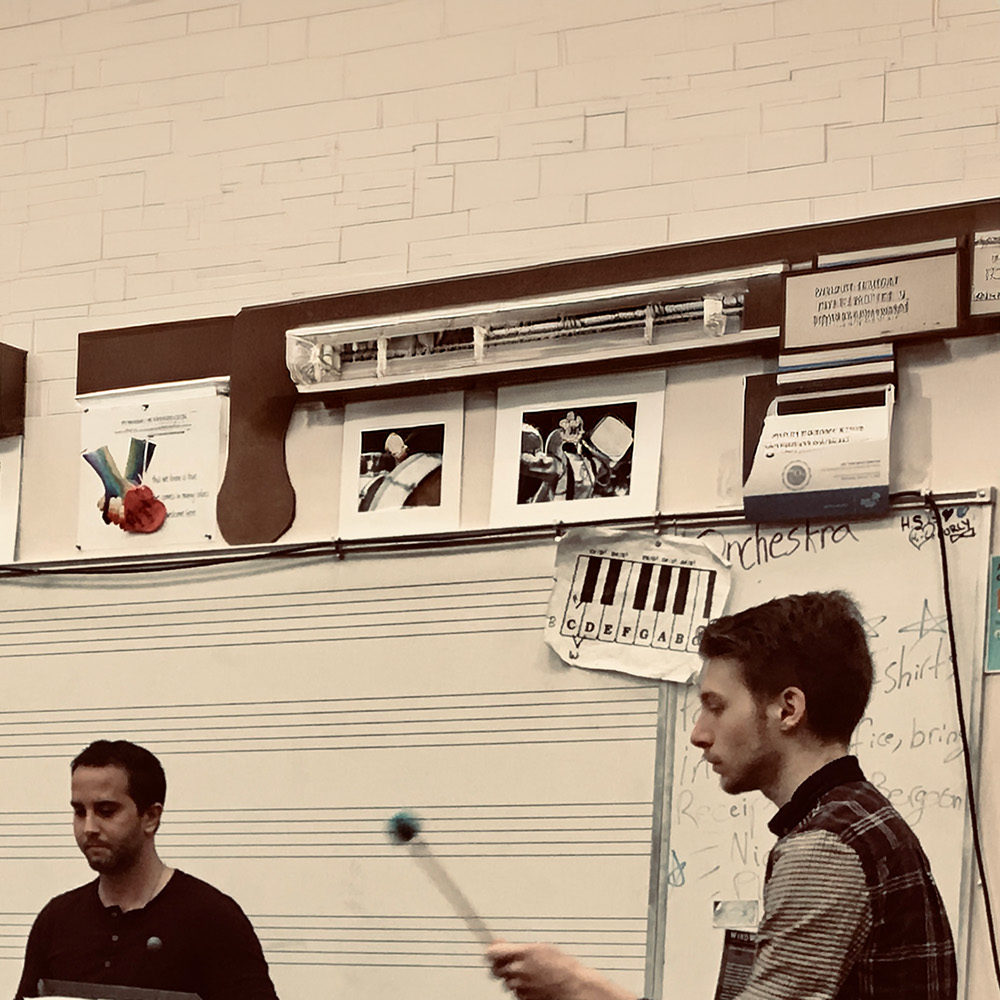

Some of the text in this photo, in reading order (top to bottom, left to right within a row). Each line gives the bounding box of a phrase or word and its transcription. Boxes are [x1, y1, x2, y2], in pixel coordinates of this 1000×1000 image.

[943, 518, 972, 537] URLY
[567, 619, 576, 630] C
[584, 621, 595, 633] D
[603, 624, 613, 635] E
[621, 626, 632, 637] F
[639, 629, 649, 640] G
[657, 631, 667, 643] A
[674, 634, 685, 645] B
